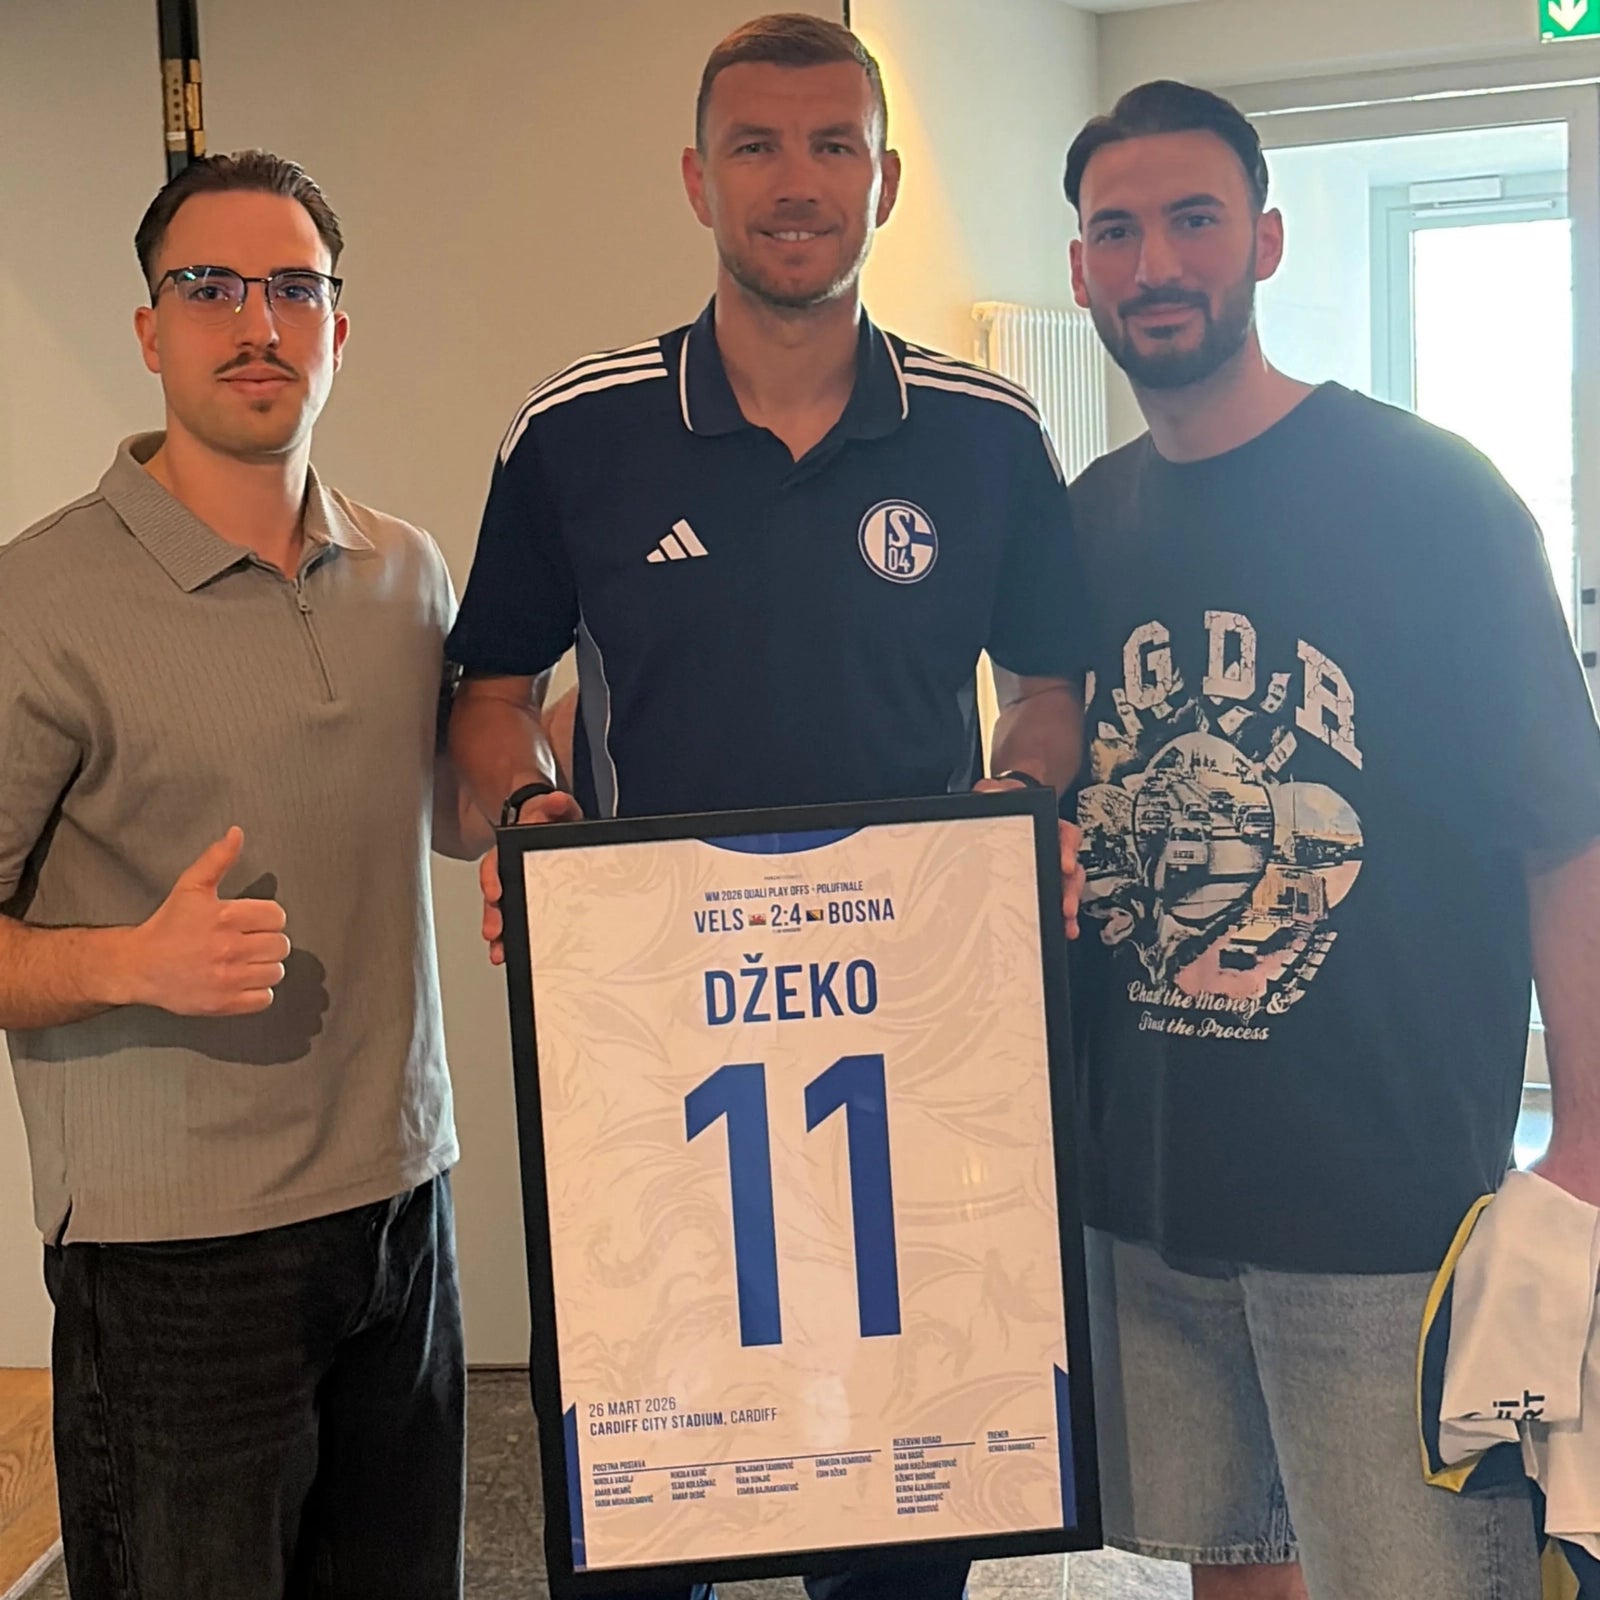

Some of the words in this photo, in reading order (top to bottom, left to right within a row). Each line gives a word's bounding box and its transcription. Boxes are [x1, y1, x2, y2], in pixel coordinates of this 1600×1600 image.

[705, 891, 720, 902] WM
[722, 889, 743, 901] 2026
[744, 887, 767, 900] QUALI
[769, 885, 788, 898] PLAY
[790, 884, 810, 896] OFFS
[816, 881, 864, 894] POLUFINALE
[694, 908, 744, 934] VELS
[771, 902, 801, 927] 2:4
[828, 898, 896, 924] BOSNA
[704, 953, 878, 1026] DŽEKO
[1163, 987, 1193, 1009] the
[1195, 991, 1264, 1020] Money
[1266, 992, 1292, 1015] &
[1167, 1017, 1195, 1036] the
[1197, 1018, 1270, 1040] Process
[684, 1053, 902, 1348] 11
[588, 1403, 604, 1418] 26
[608, 1400, 641, 1416] MART
[645, 1396, 676, 1413] 2026
[590, 1419, 638, 1436] CARDIFF
[642, 1416, 668, 1432] CITY
[671, 1411, 727, 1429] STADIUM,
[730, 1407, 778, 1424] CARDIFF
